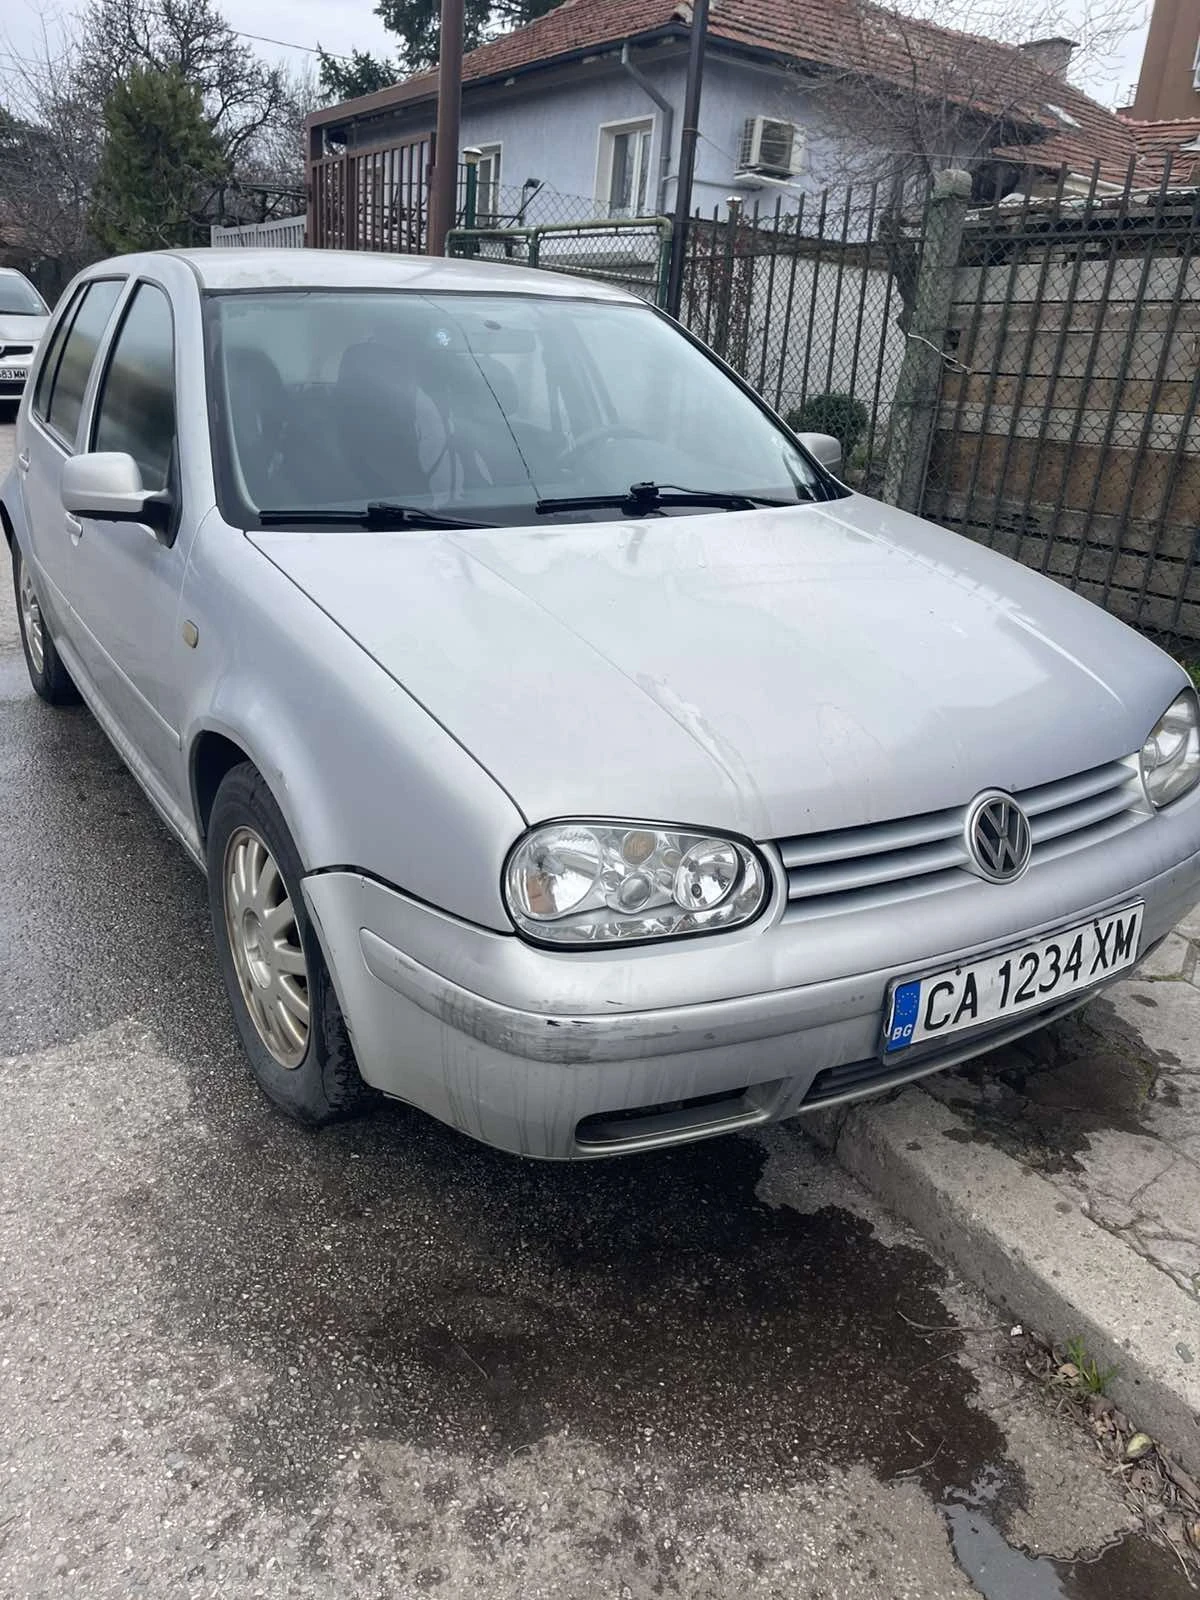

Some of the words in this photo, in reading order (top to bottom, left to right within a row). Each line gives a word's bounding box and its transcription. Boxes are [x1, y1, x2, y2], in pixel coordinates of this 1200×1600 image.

[0, 369, 13, 379] 83
[972, 798, 1027, 877] VW
[924, 973, 978, 1031] CA
[998, 933, 1083, 1009] 1234
[1090, 914, 1137, 976] XM
[892, 1023, 913, 1041] BG
